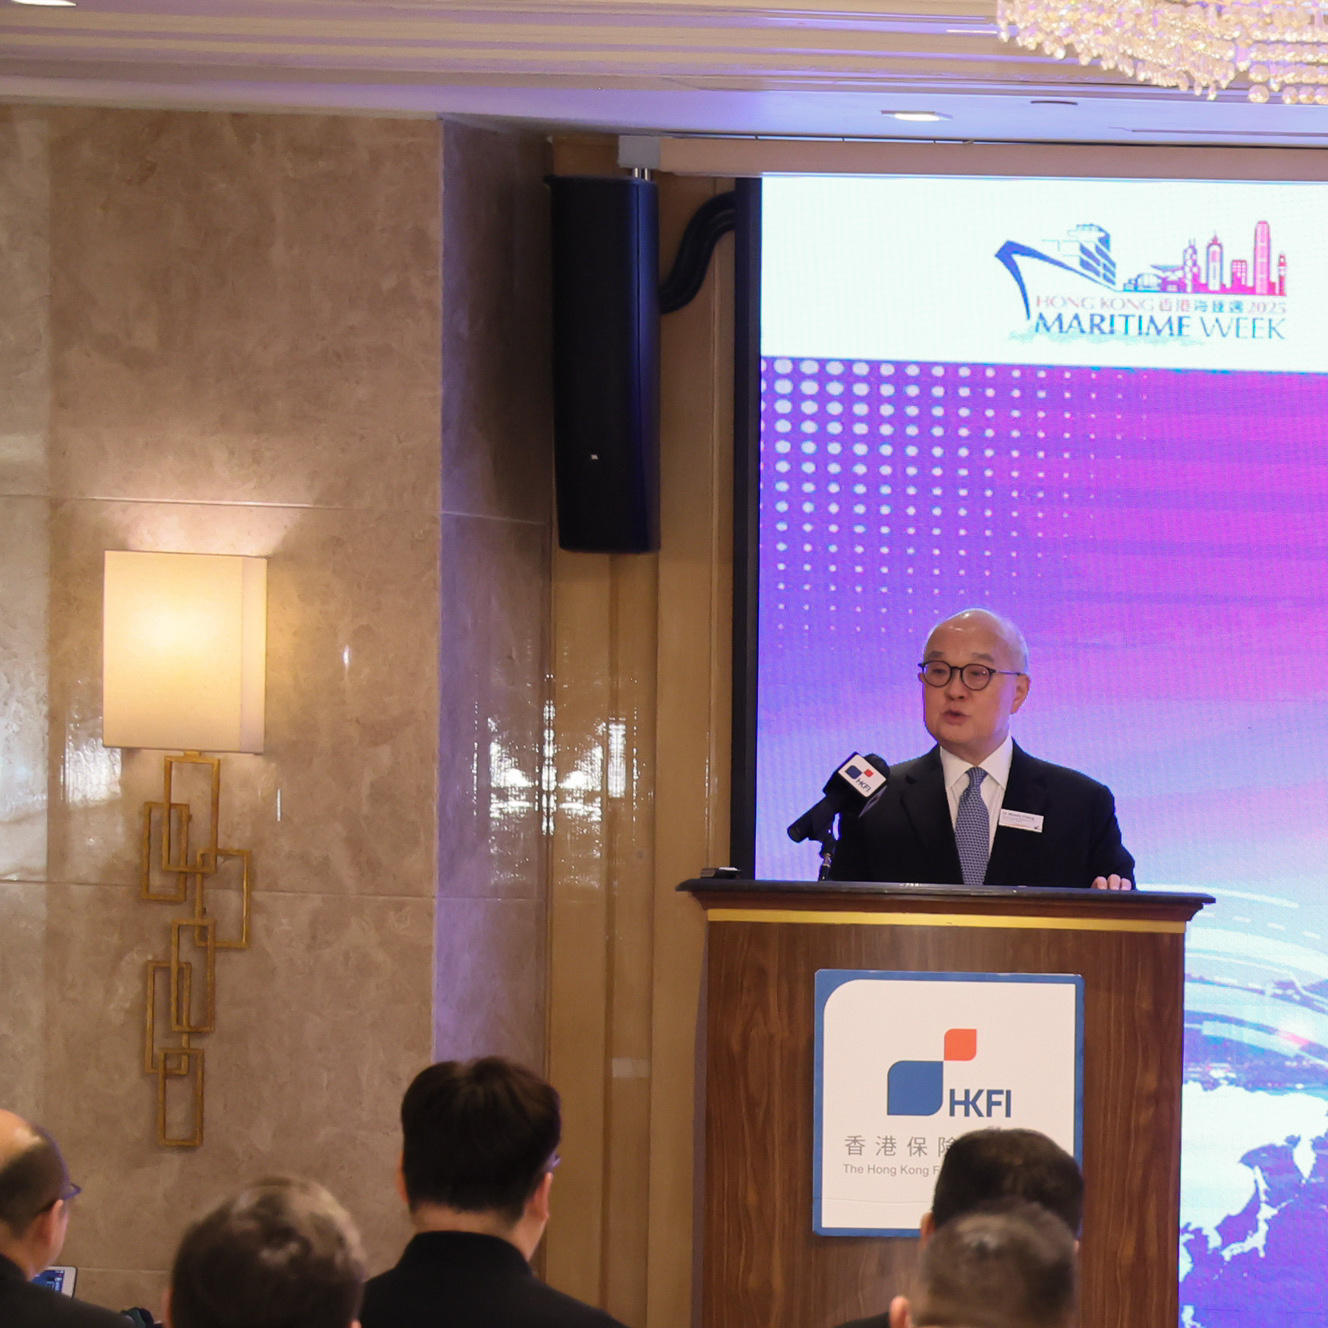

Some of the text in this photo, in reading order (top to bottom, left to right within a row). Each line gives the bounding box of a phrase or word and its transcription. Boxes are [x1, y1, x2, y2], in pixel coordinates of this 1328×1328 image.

[1036, 296, 1154, 311] HONG KONG
[1035, 312, 1287, 340] MARITIME WEEK
[949, 1089, 1012, 1118] HKFI
[843, 1163, 864, 1175] The
[867, 1163, 897, 1177] Hong
[900, 1164, 930, 1177] Kong
